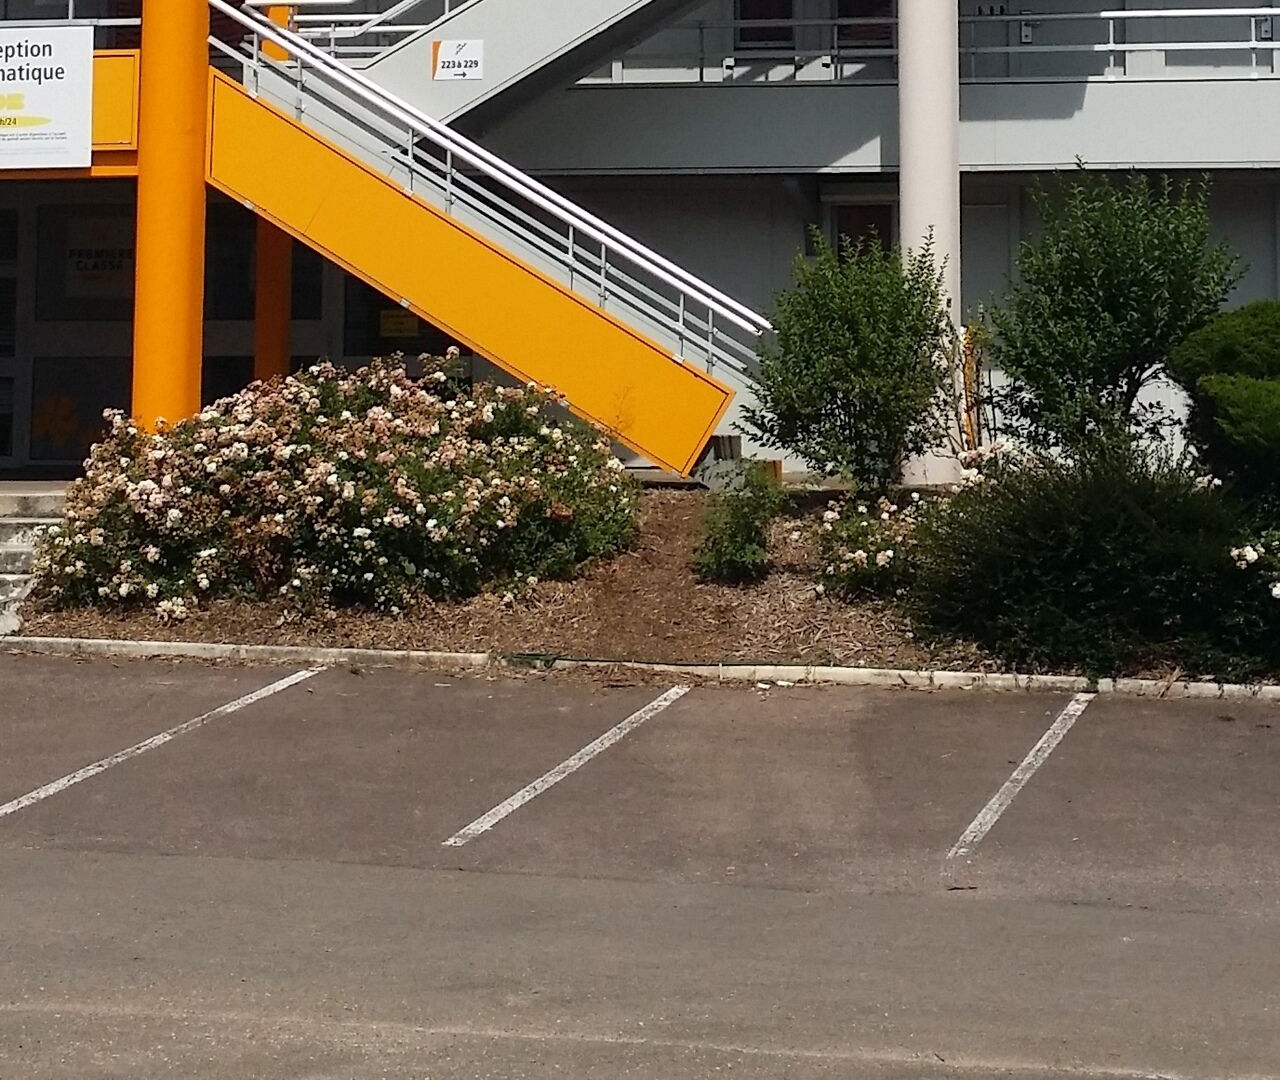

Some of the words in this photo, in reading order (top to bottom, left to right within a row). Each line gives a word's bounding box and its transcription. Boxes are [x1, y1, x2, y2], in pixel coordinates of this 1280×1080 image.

[441, 60, 456, 69] 223
[456, 59, 462, 68] à
[463, 59, 479, 68] 229
